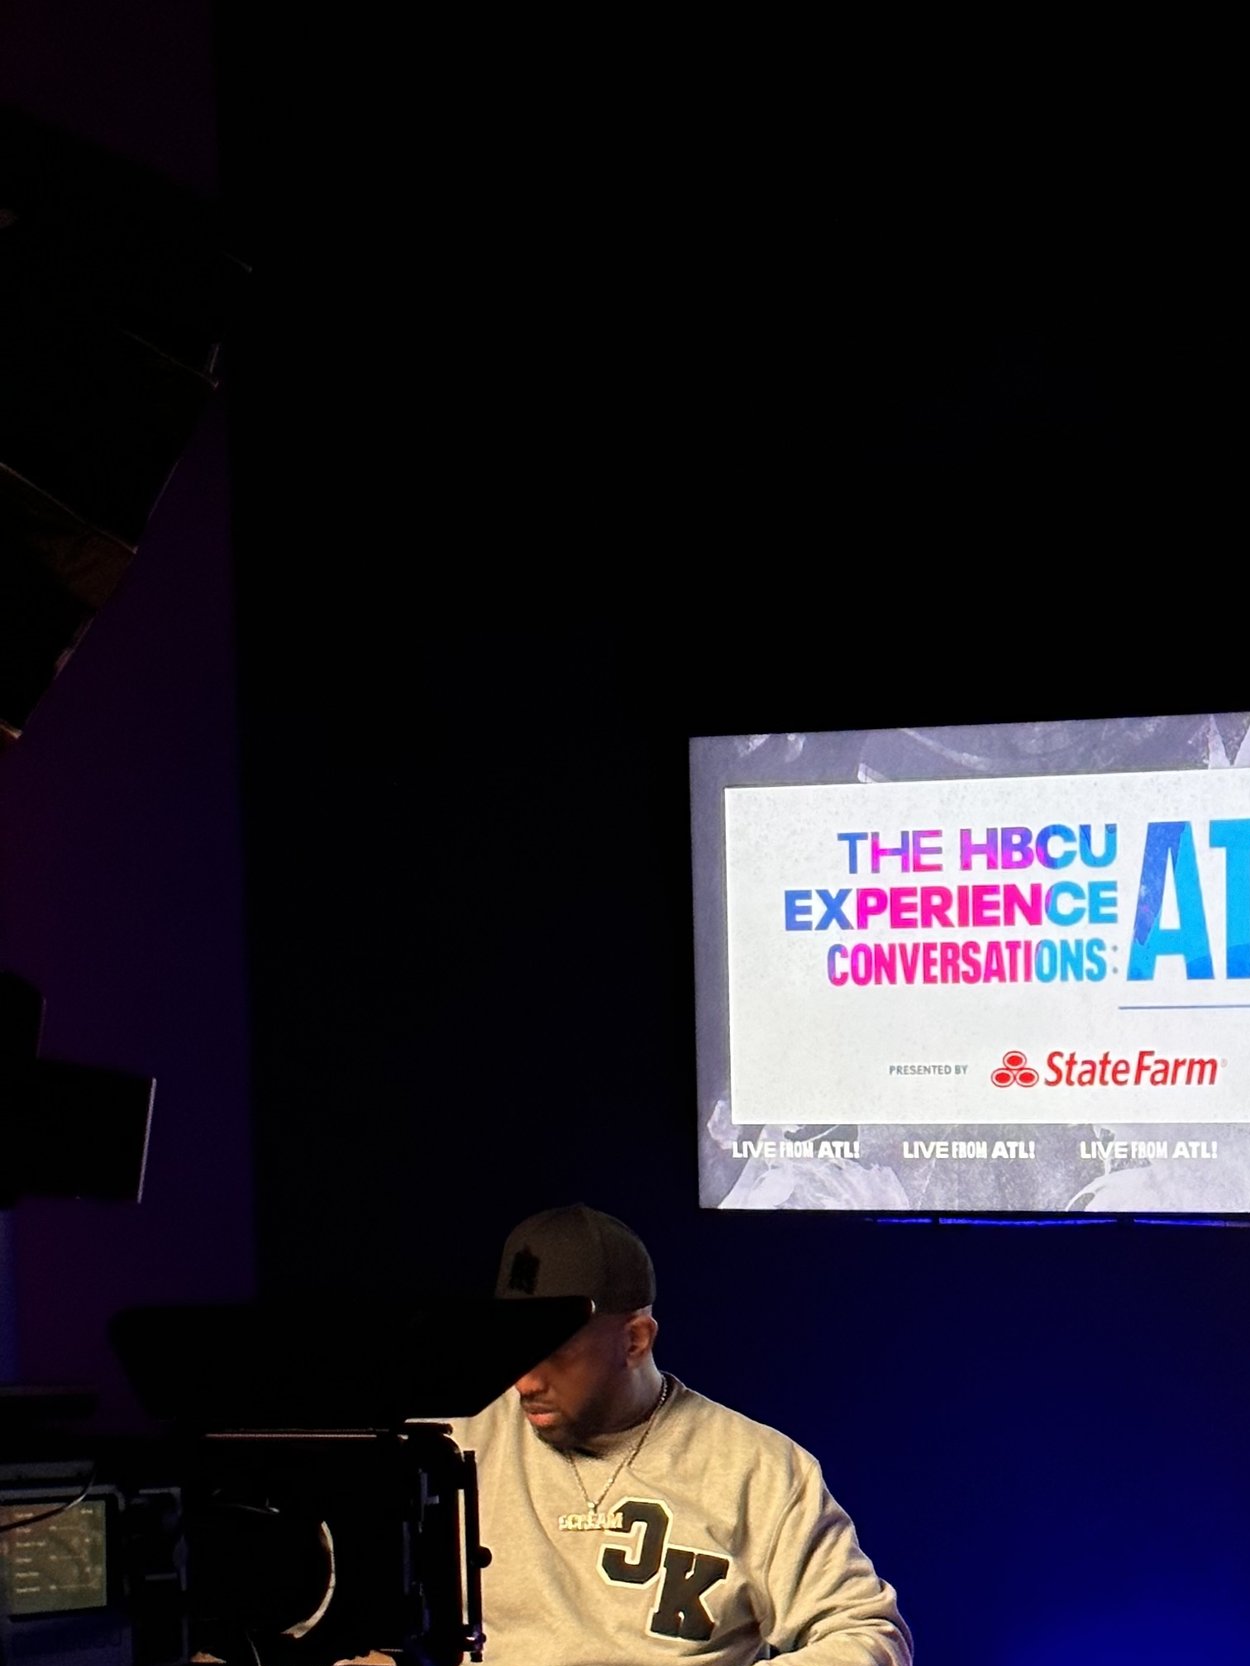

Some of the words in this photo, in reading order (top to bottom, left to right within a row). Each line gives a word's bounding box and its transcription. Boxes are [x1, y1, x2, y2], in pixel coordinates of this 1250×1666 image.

[837, 829, 943, 874] THE
[960, 823, 1117, 871] HBCU
[785, 880, 1118, 931] EXPERIENCE
[889, 1064, 952, 1076] PRESENTED
[954, 1064, 968, 1075] BY
[732, 1141, 777, 1159] LIVE
[780, 1141, 814, 1159] FROM
[817, 1141, 860, 1159] ATL!
[903, 1141, 949, 1159] LIVE
[951, 1141, 987, 1159] FROM
[991, 1141, 1035, 1159] ATL!
[1080, 1141, 1128, 1159] LIVE
[1131, 1141, 1168, 1159] FROM
[1172, 1141, 1217, 1159] ATL!
